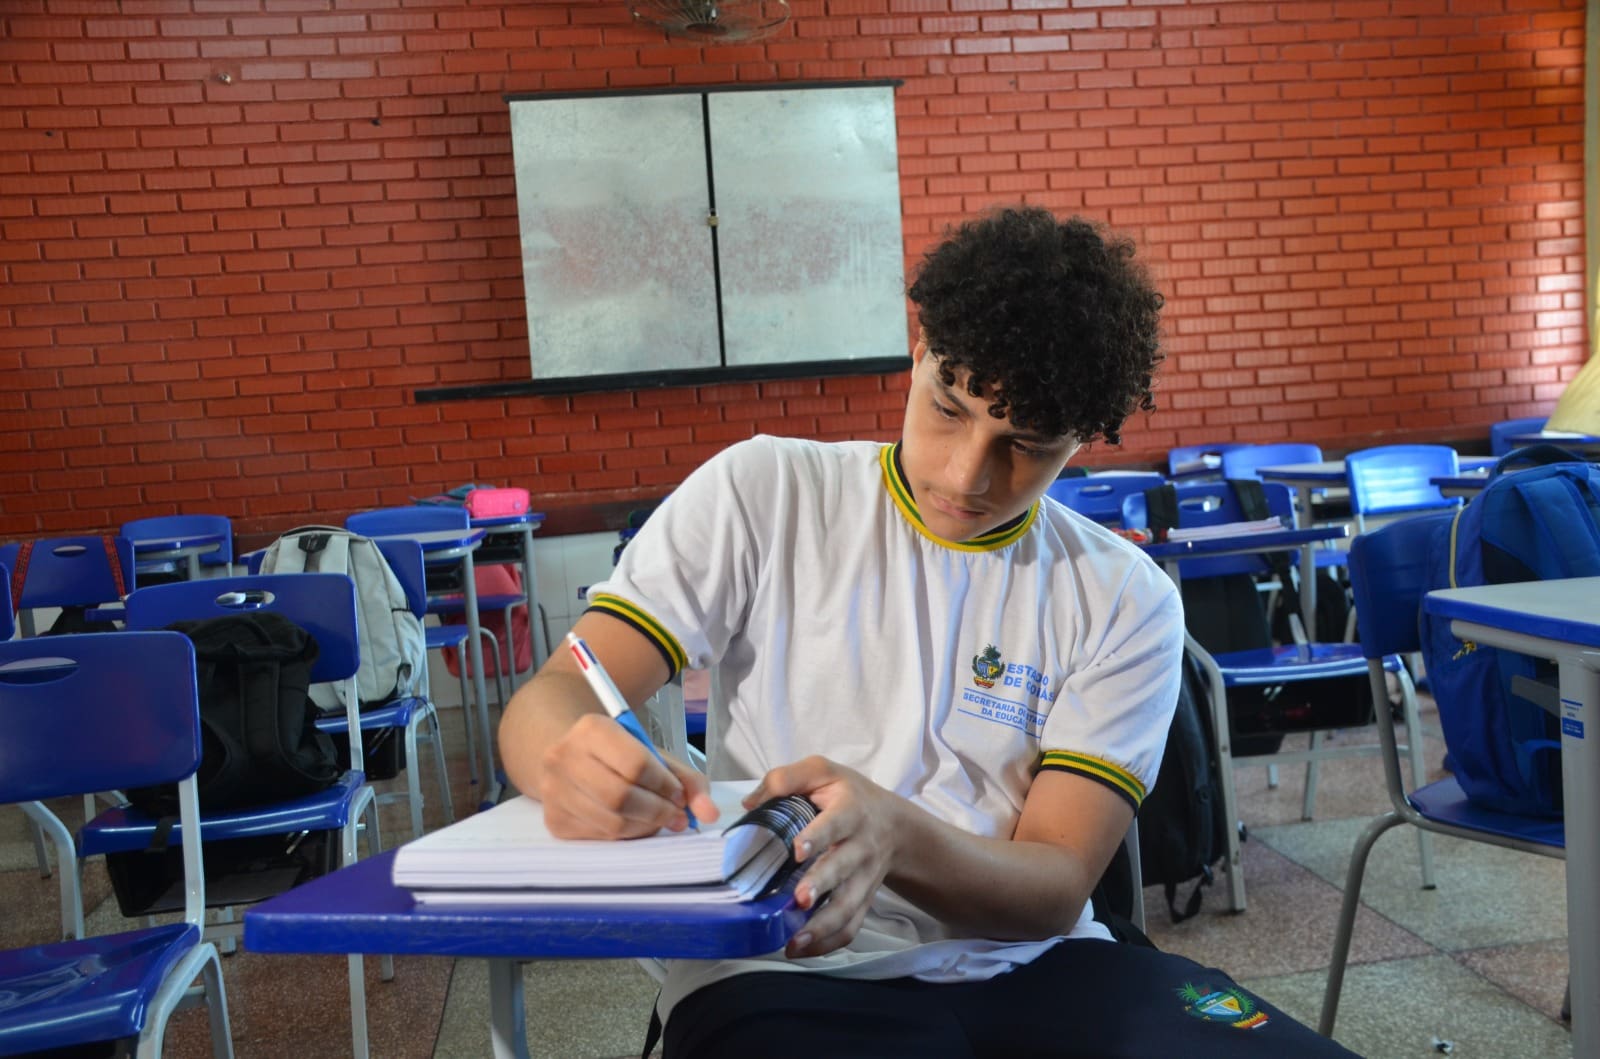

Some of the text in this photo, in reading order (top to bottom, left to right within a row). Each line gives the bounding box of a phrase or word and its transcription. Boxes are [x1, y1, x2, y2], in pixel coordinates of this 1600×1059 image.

[1003, 676, 1023, 688] DE
[1007, 663, 1049, 686] ESTADO
[963, 692, 1016, 714] SECRETARIA
[981, 707, 993, 717] DA
